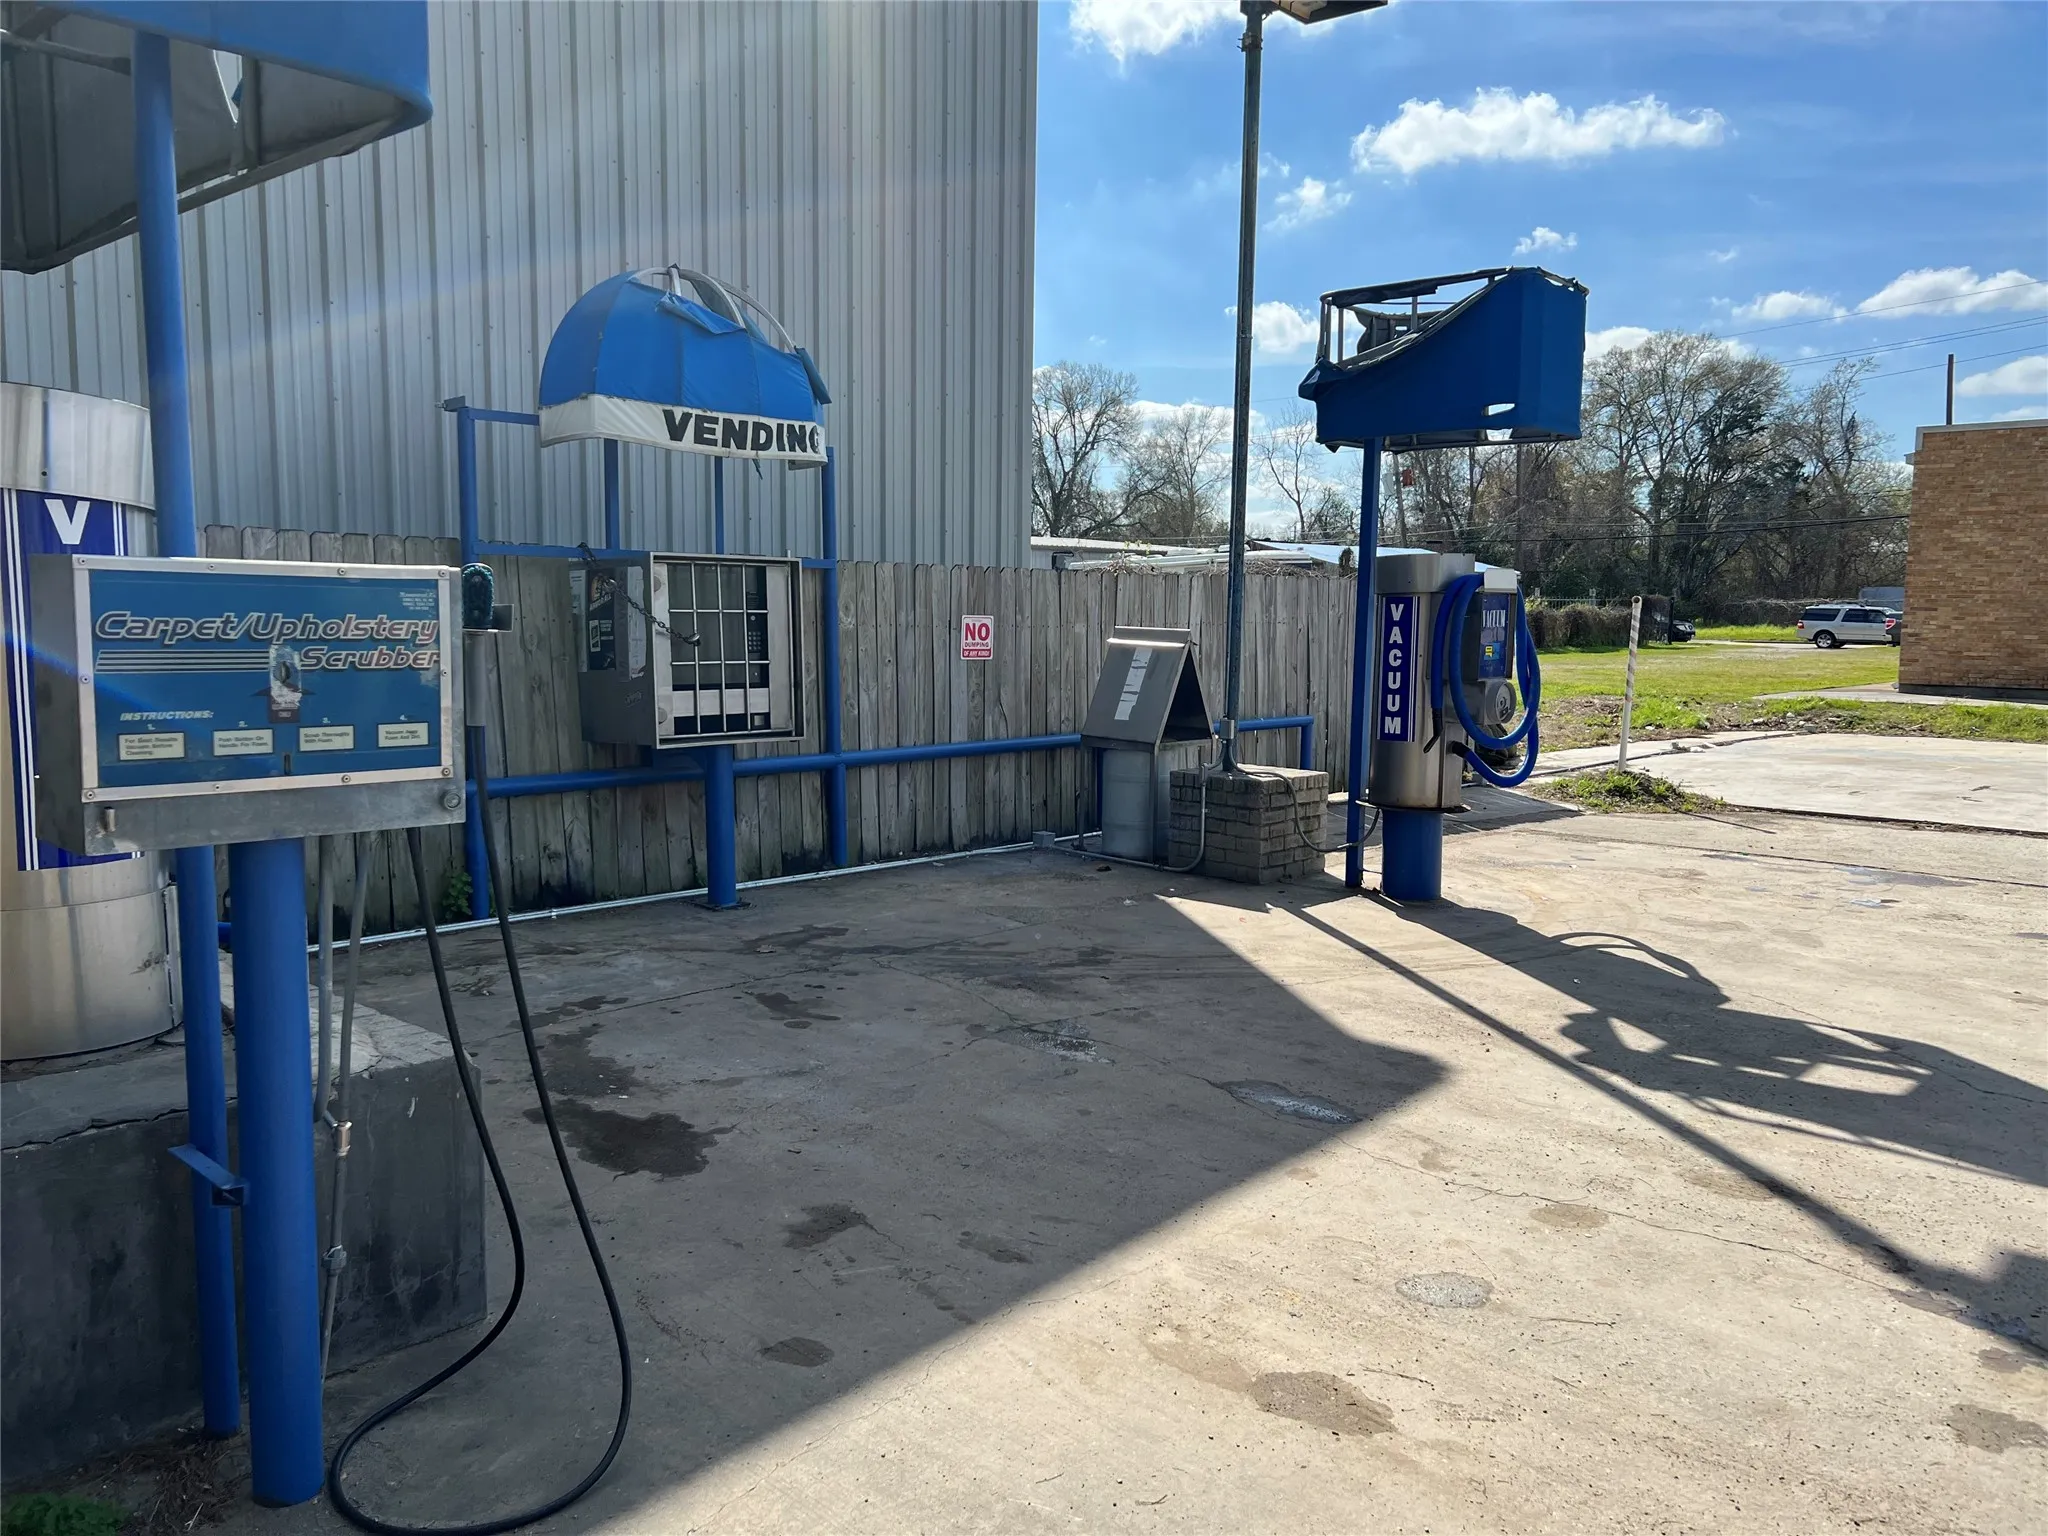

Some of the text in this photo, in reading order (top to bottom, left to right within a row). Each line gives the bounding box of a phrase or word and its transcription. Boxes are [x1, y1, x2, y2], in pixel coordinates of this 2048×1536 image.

[662, 409, 820, 454] VENDING
[96, 611, 438, 645] Carpet/Upholstery
[1482, 609, 1506, 628] VACUUM
[965, 622, 990, 641] NO
[300, 646, 440, 670] Scrubber
[1384, 603, 1405, 735] VACUUM
[120, 710, 214, 721] INSTRUCTIONS:
